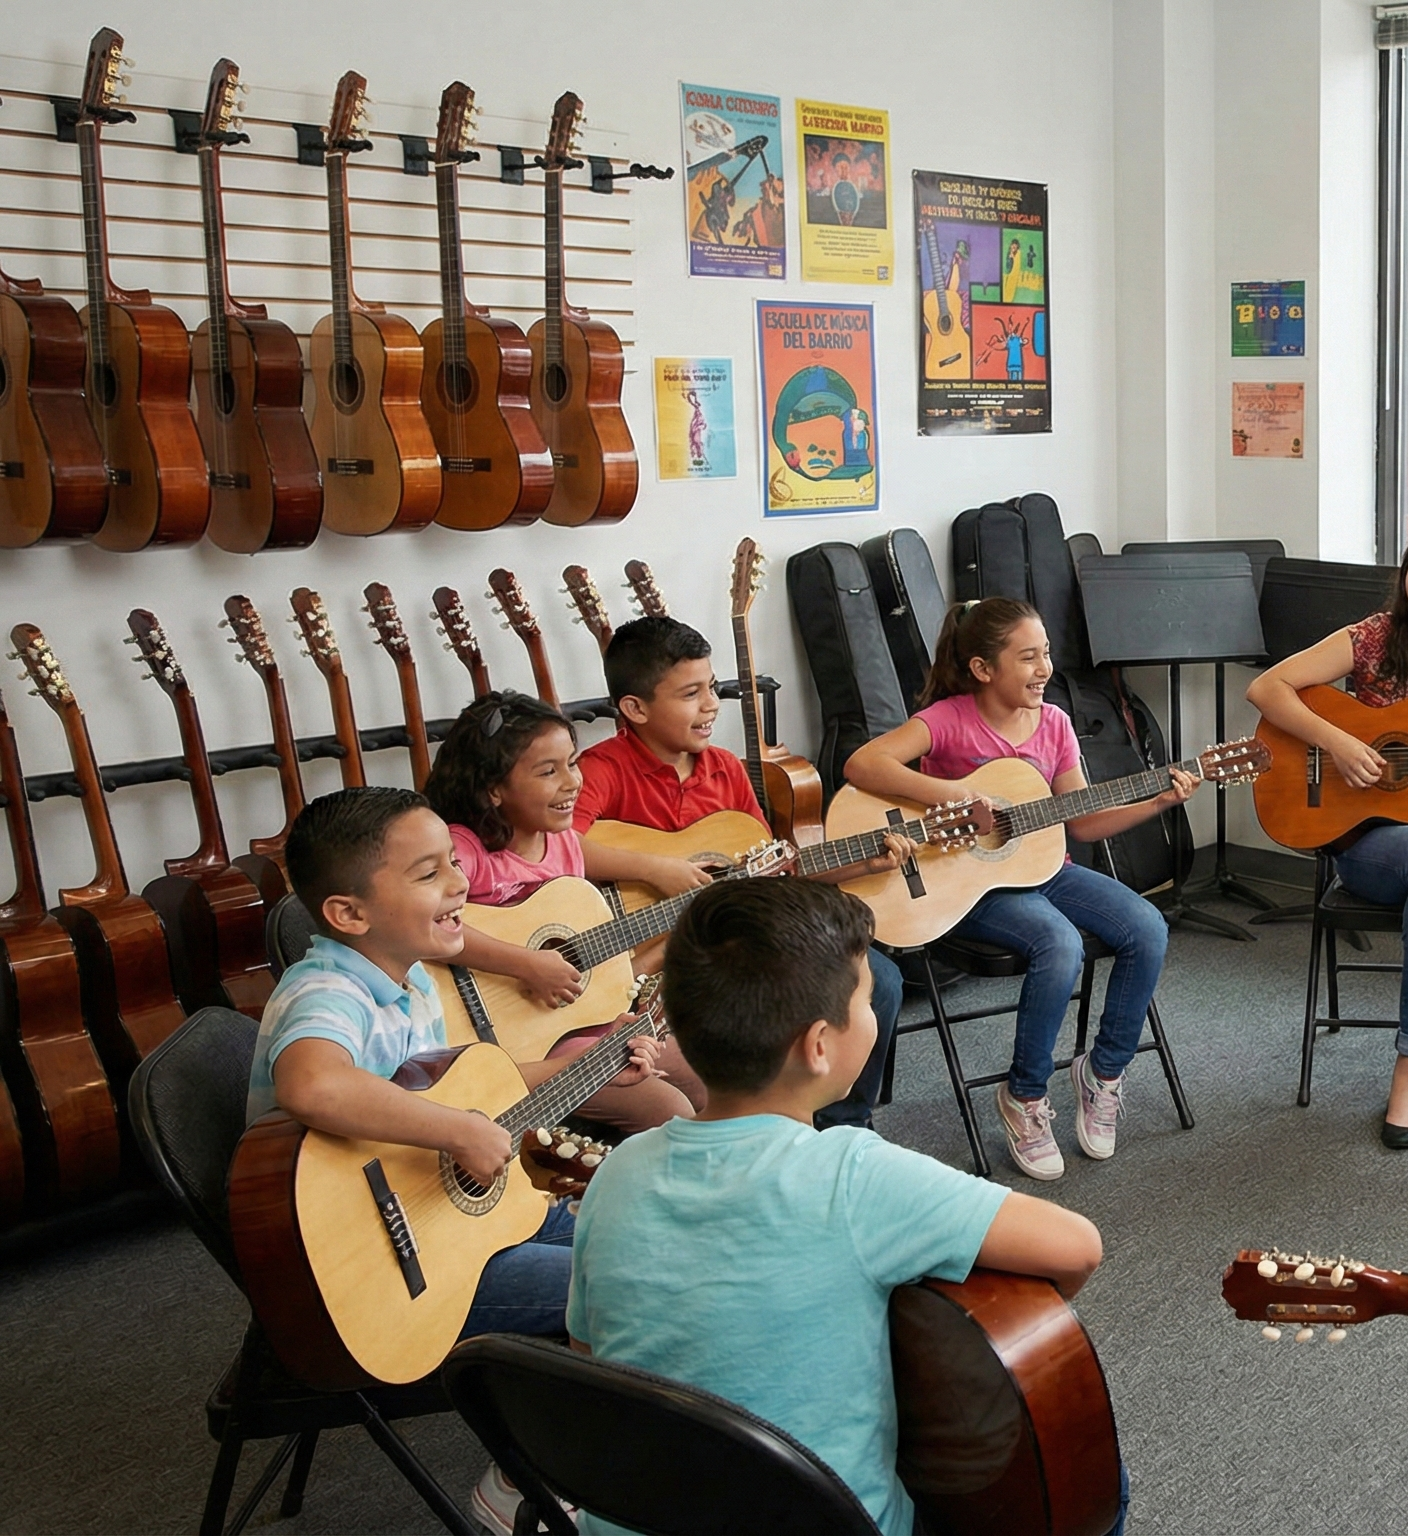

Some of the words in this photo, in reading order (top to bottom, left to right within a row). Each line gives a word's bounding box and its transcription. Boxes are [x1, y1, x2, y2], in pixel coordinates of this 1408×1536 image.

[765, 311, 812, 330] ESCUELA
[814, 313, 829, 331] DE
[783, 331, 806, 349] DEL
[808, 332, 853, 350] BARRIO
